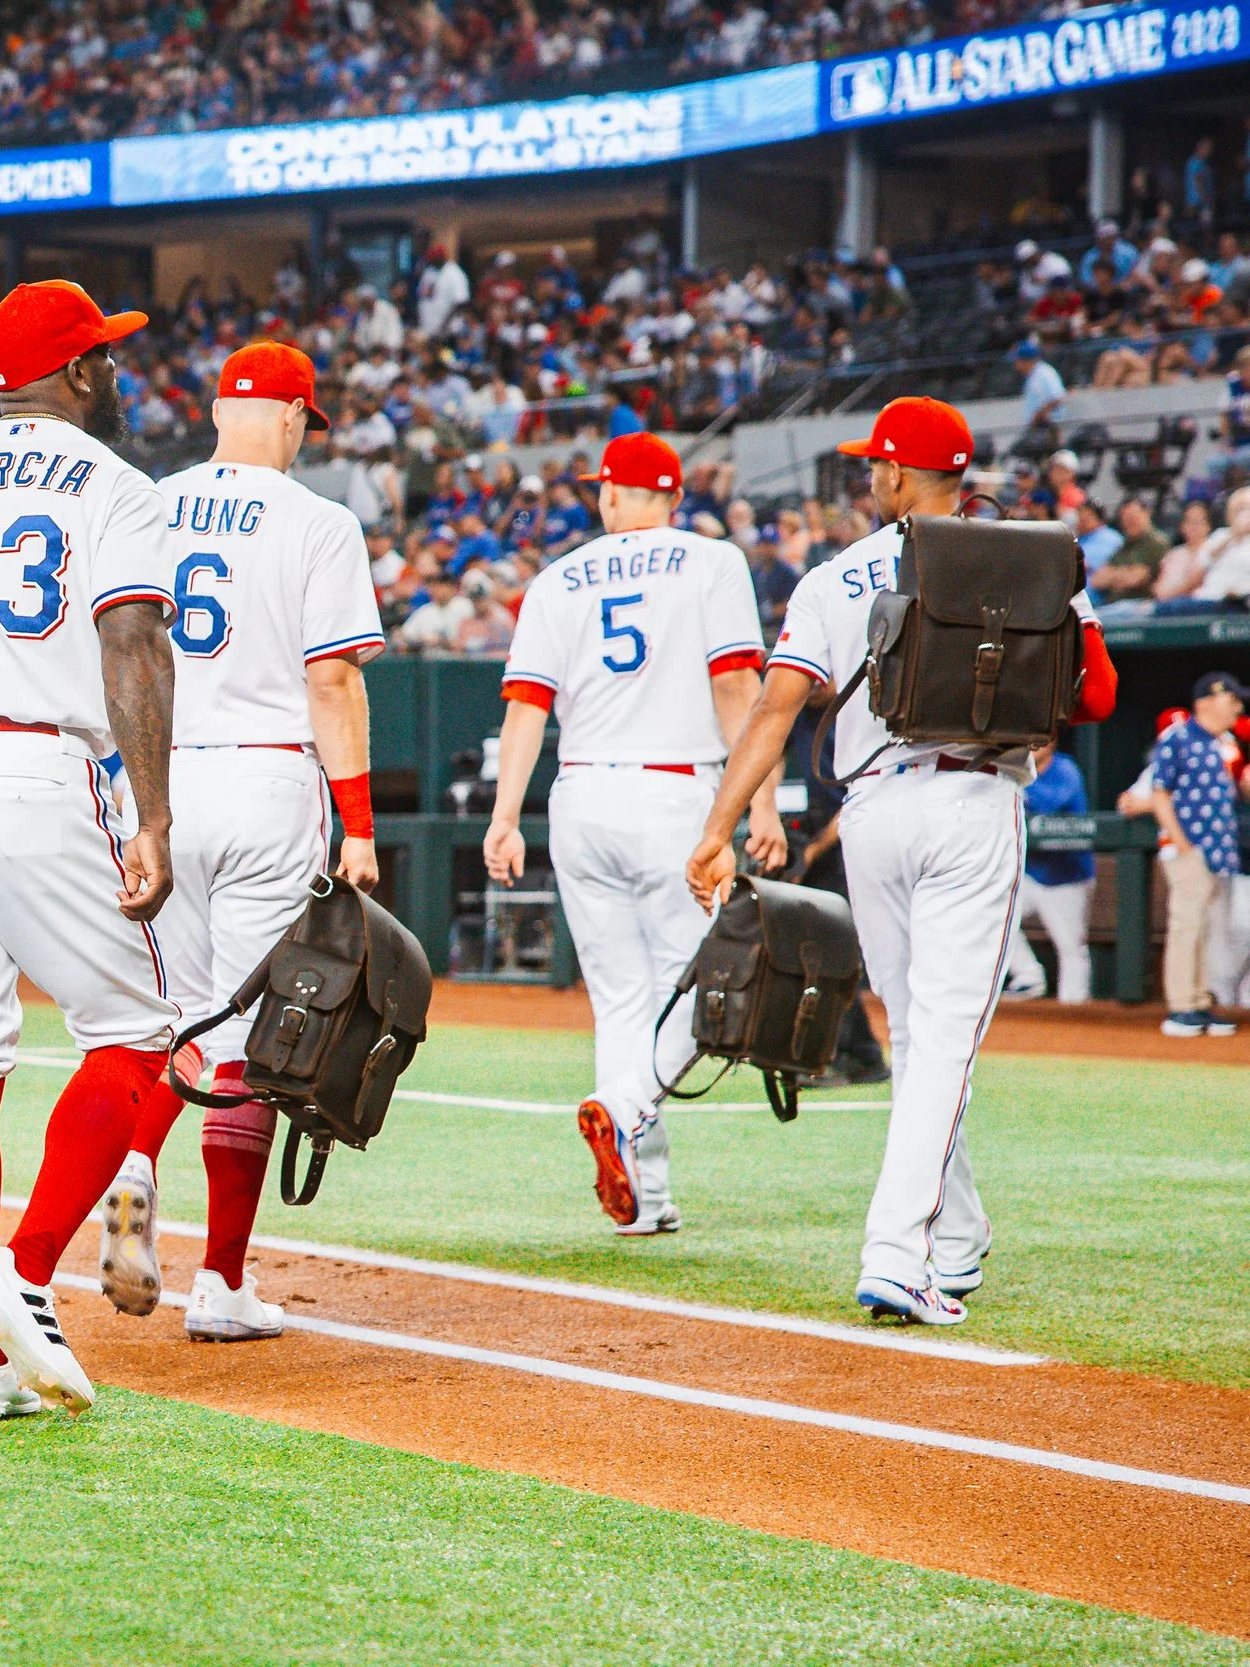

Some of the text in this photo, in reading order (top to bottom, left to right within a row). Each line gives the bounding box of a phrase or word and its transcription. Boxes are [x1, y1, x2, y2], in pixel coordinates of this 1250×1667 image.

[958, 31, 1054, 102] STAR
[1051, 9, 1167, 86] GAME
[1171, 4, 1240, 59] 2023
[226, 94, 682, 165] CONGRATULATIONS
[229, 163, 281, 191] TO
[284, 155, 364, 188] OUR
[167, 495, 267, 537] JUNG
[562, 546, 688, 593] SEAGER
[170, 552, 234, 660] 6
[600, 592, 653, 680] 5
